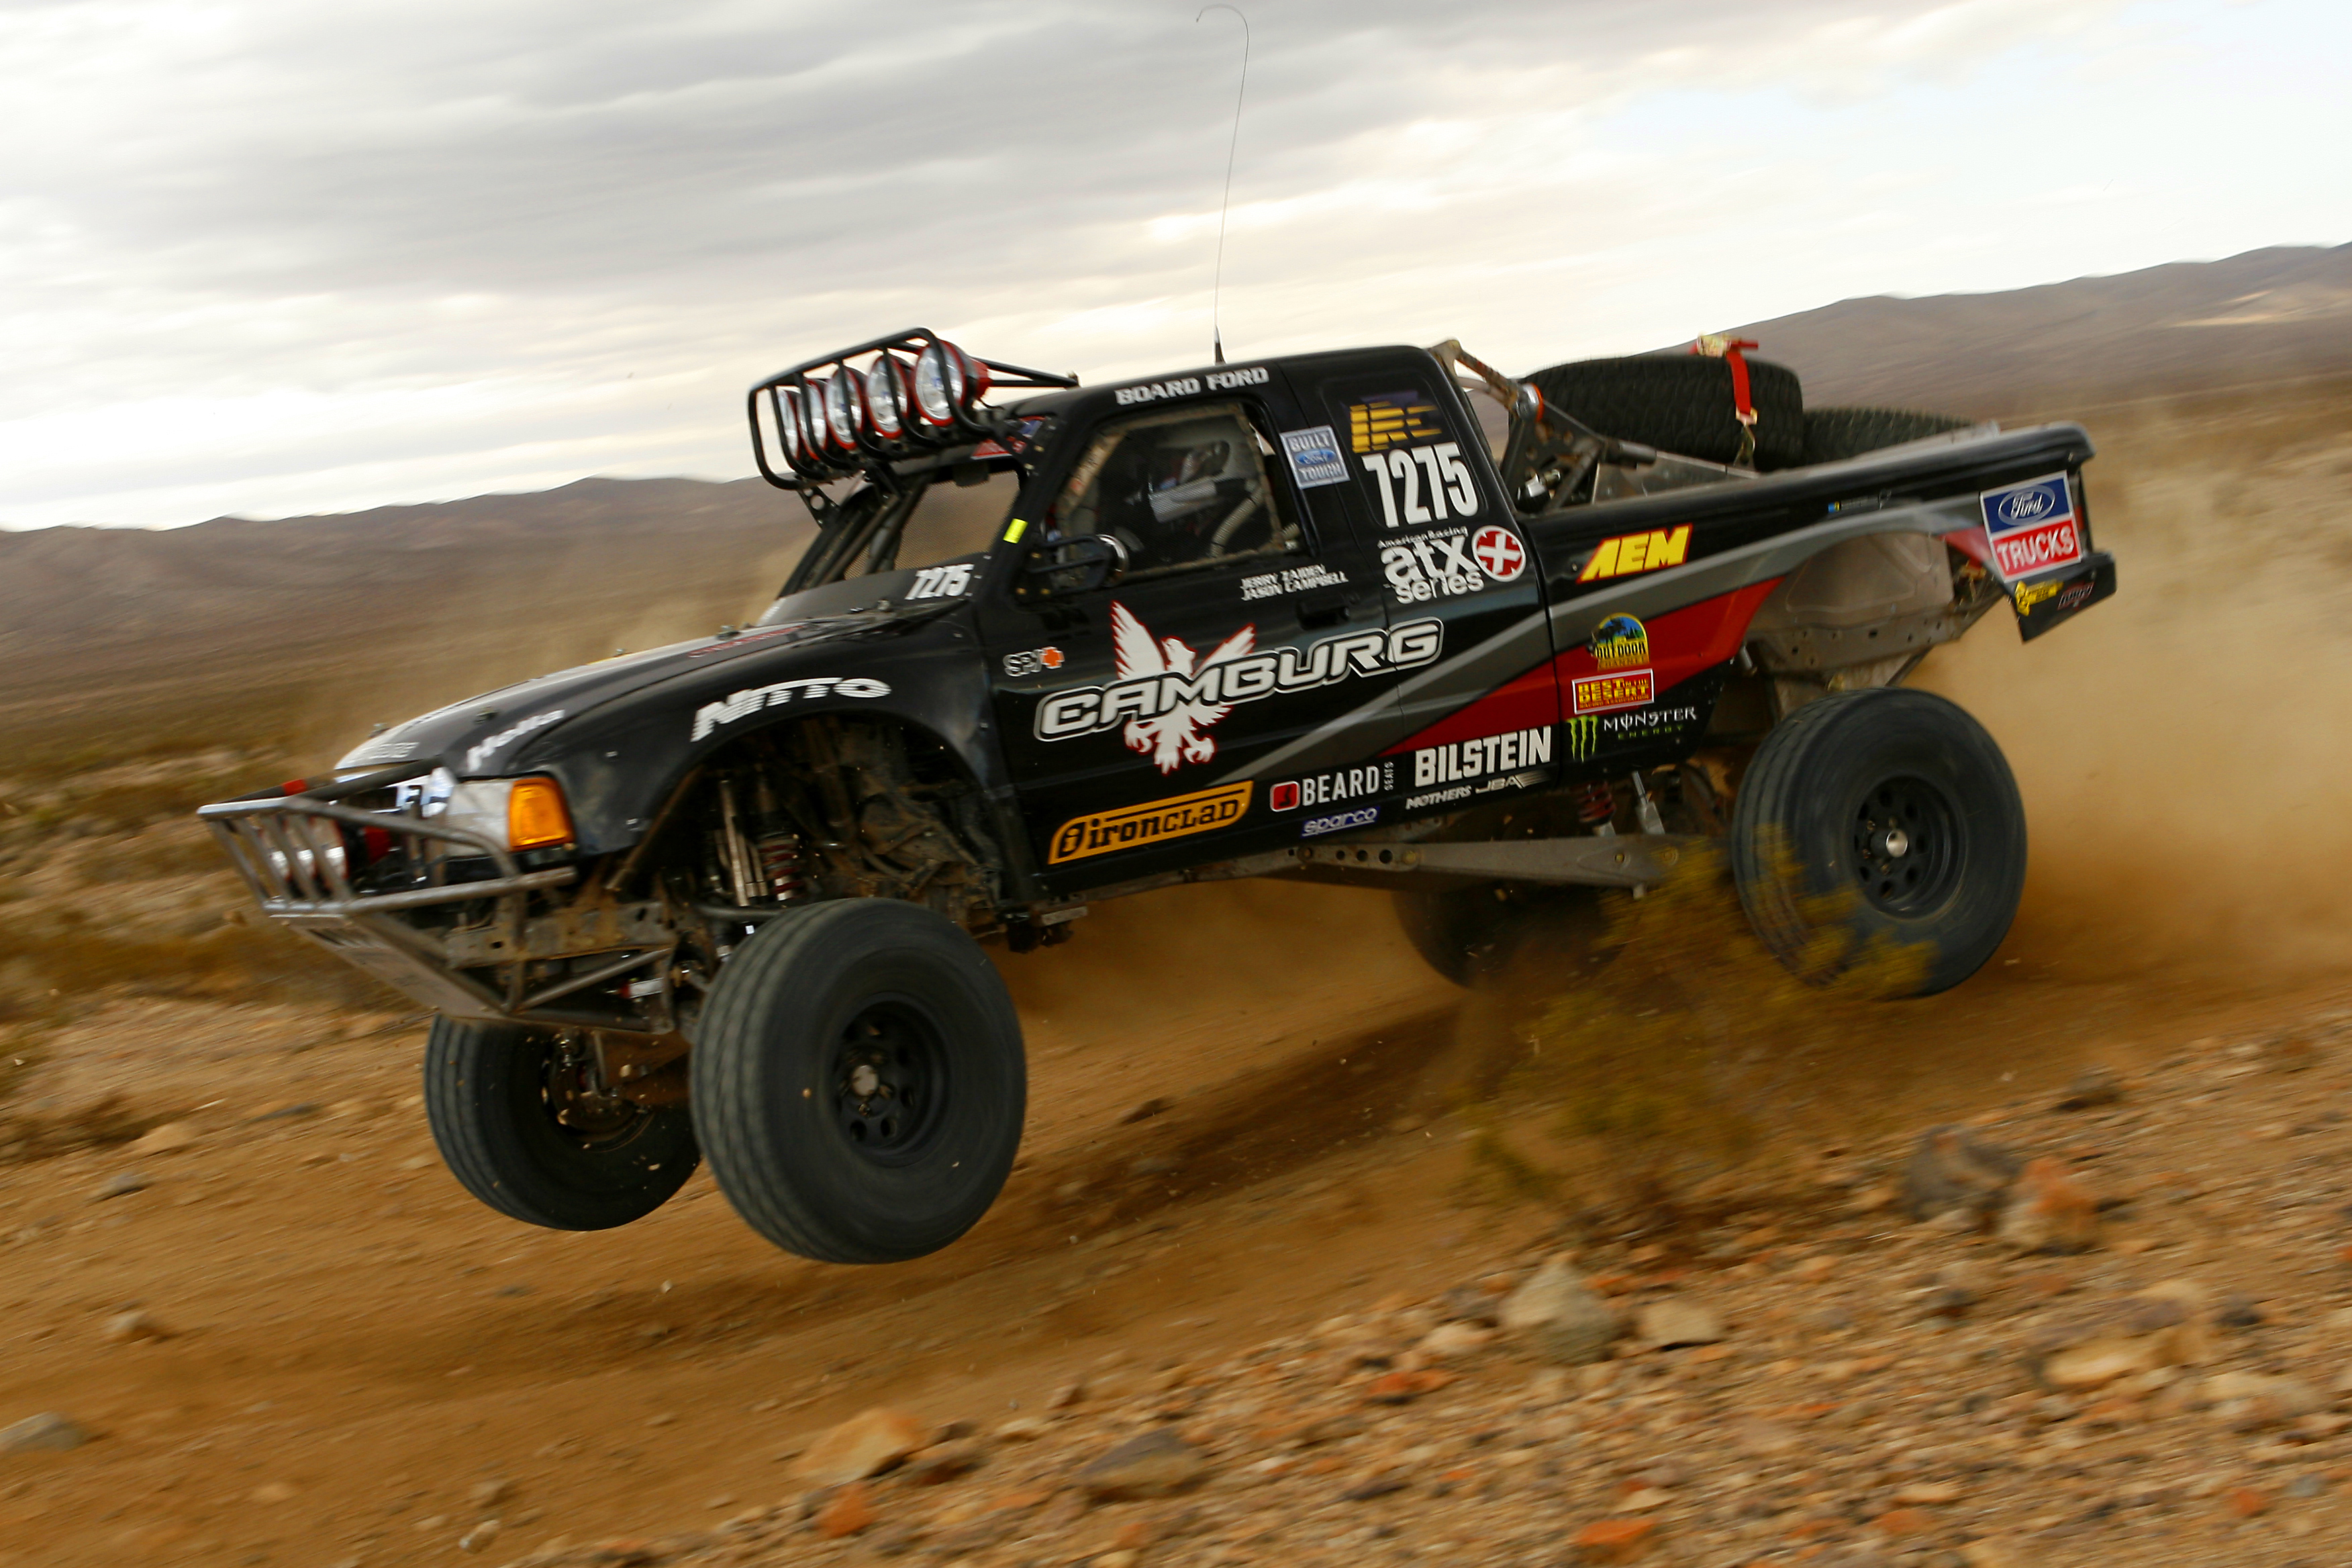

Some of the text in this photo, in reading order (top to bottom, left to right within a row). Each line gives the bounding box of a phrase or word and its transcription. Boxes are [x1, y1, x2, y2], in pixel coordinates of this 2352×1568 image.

[1114, 366, 1270, 405] BOARD FORD
[1287, 433, 1330, 452] BUILT
[1361, 441, 1478, 528] 7275
[2010, 491, 2044, 520] Ford
[1381, 535, 1479, 587] atx
[1578, 524, 1691, 582] AEM
[1997, 525, 2074, 571] TRUCKS
[1394, 571, 1484, 604] series
[1034, 616, 1444, 741] CAMBURG
[1578, 678, 1624, 694] BEST
[1579, 685, 1649, 703] DESERT
[691, 677, 891, 742] NITTO
[1604, 706, 1697, 731] MONSTER
[1415, 725, 1551, 787] BILSTEIN
[1302, 766, 1380, 806] BEARD
[1406, 785, 1472, 810] MOTHERS
[1303, 807, 1377, 834] sparco
